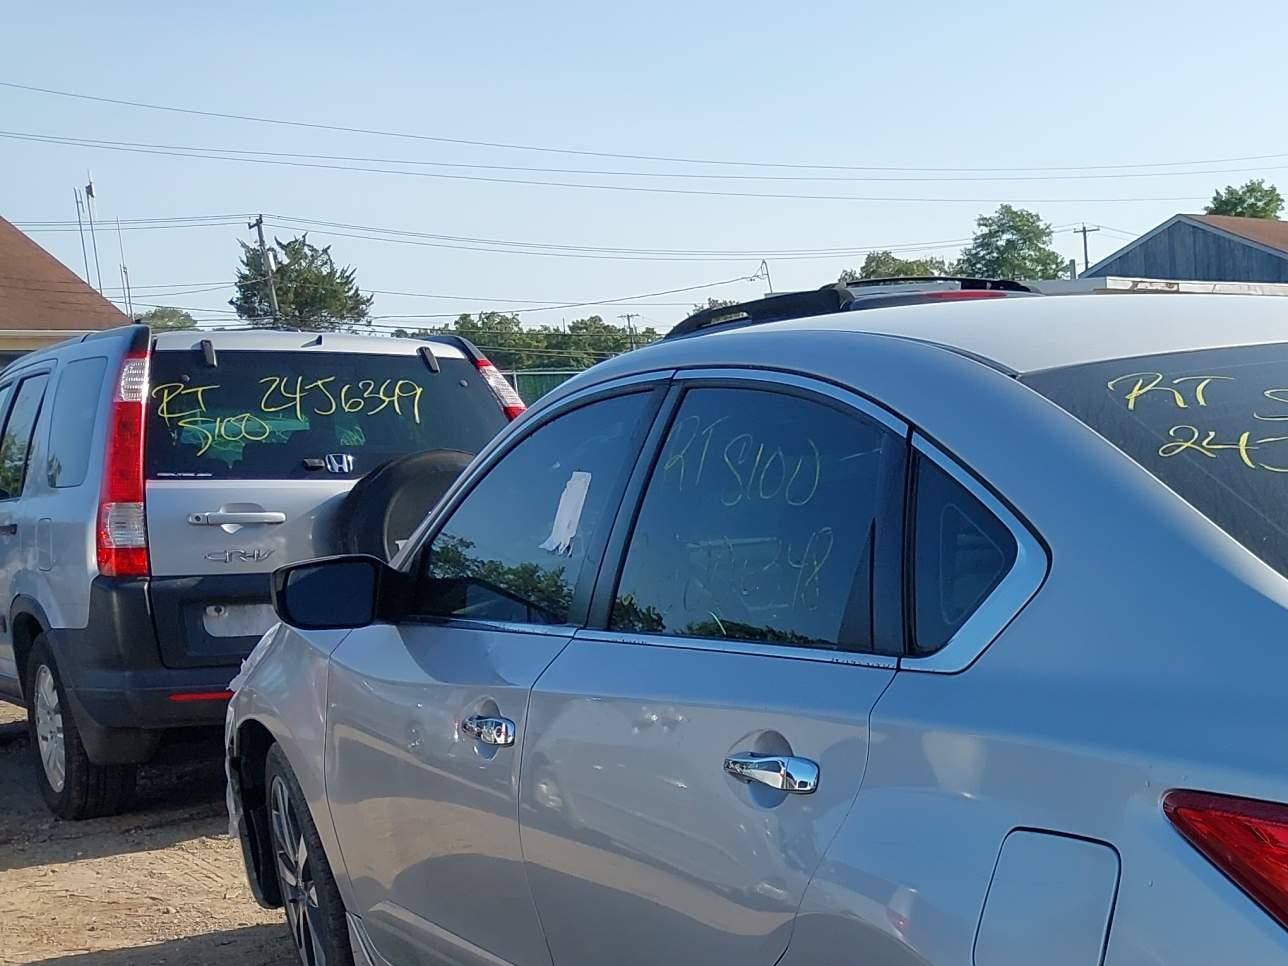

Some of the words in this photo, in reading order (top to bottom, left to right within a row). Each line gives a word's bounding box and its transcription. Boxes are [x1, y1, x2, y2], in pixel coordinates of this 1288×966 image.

[151, 383, 221, 427] RT
[1108, 372, 1236, 411] RT
[663, 415, 729, 492] RT
